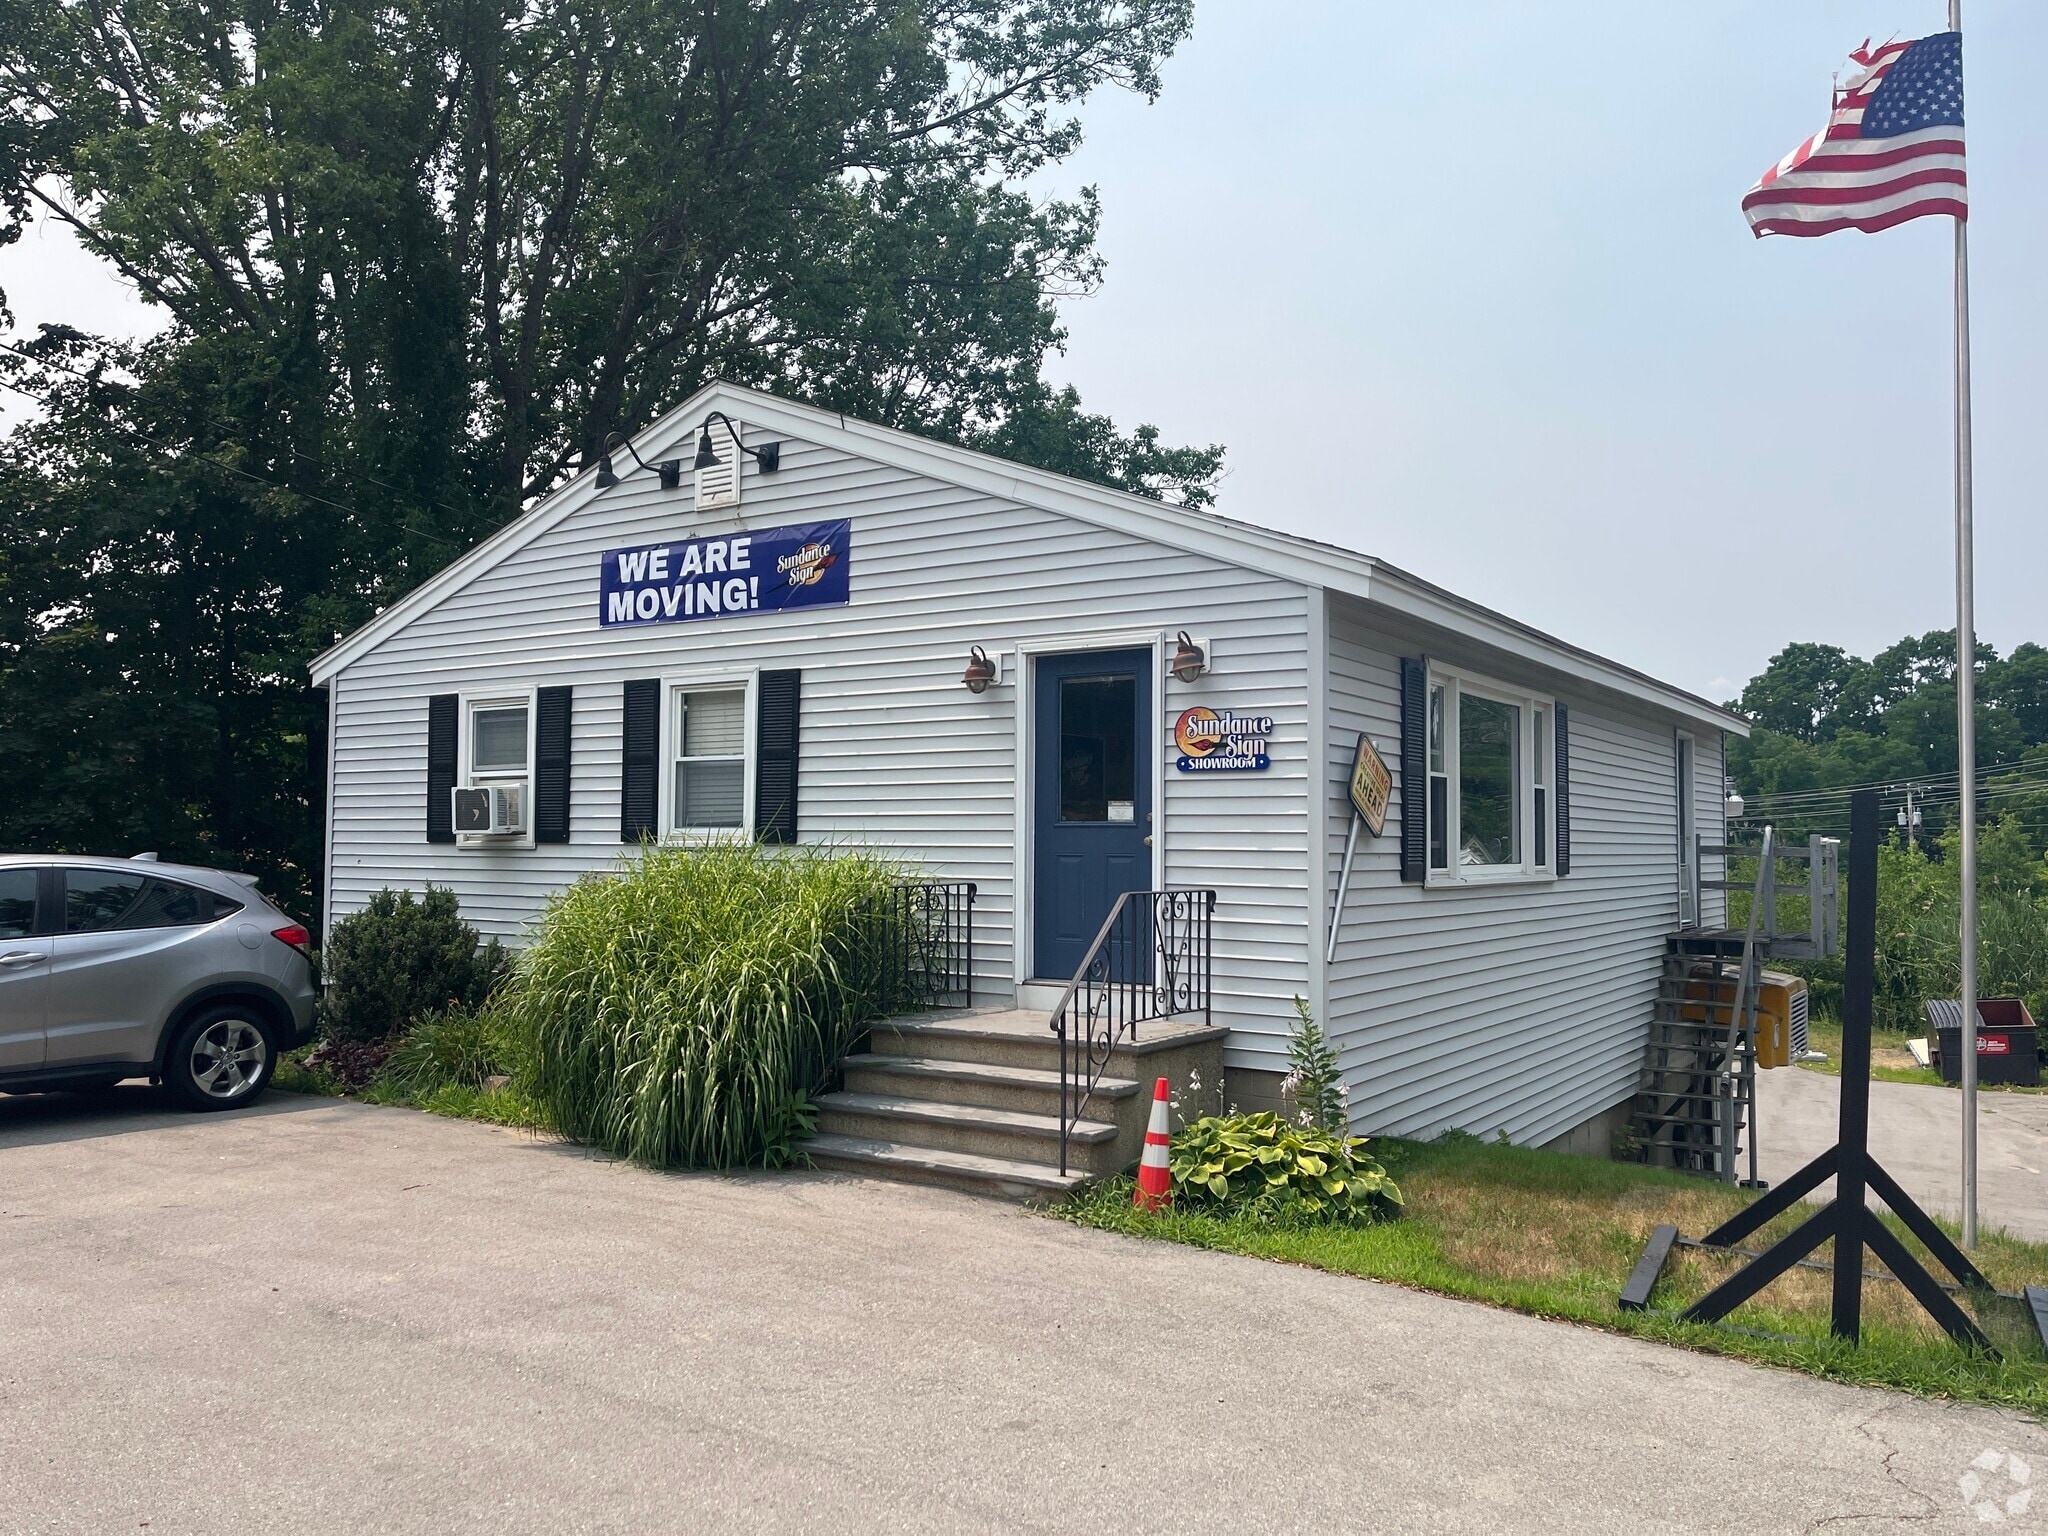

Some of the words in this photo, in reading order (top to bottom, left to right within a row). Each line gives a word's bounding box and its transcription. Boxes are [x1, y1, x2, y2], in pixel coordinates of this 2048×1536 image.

[618, 548, 669, 583] WE
[679, 537, 751, 577] ARE
[777, 544, 830, 573] Sundance
[788, 566, 814, 586] Sign
[608, 576, 759, 622] MOVING!
[1186, 711, 1272, 739] Sundance
[1225, 734, 1265, 761] Sign
[1188, 757, 1256, 769] SHOWROOM
[1363, 745, 1389, 792] WARNING
[1357, 773, 1383, 817] AHEAD
